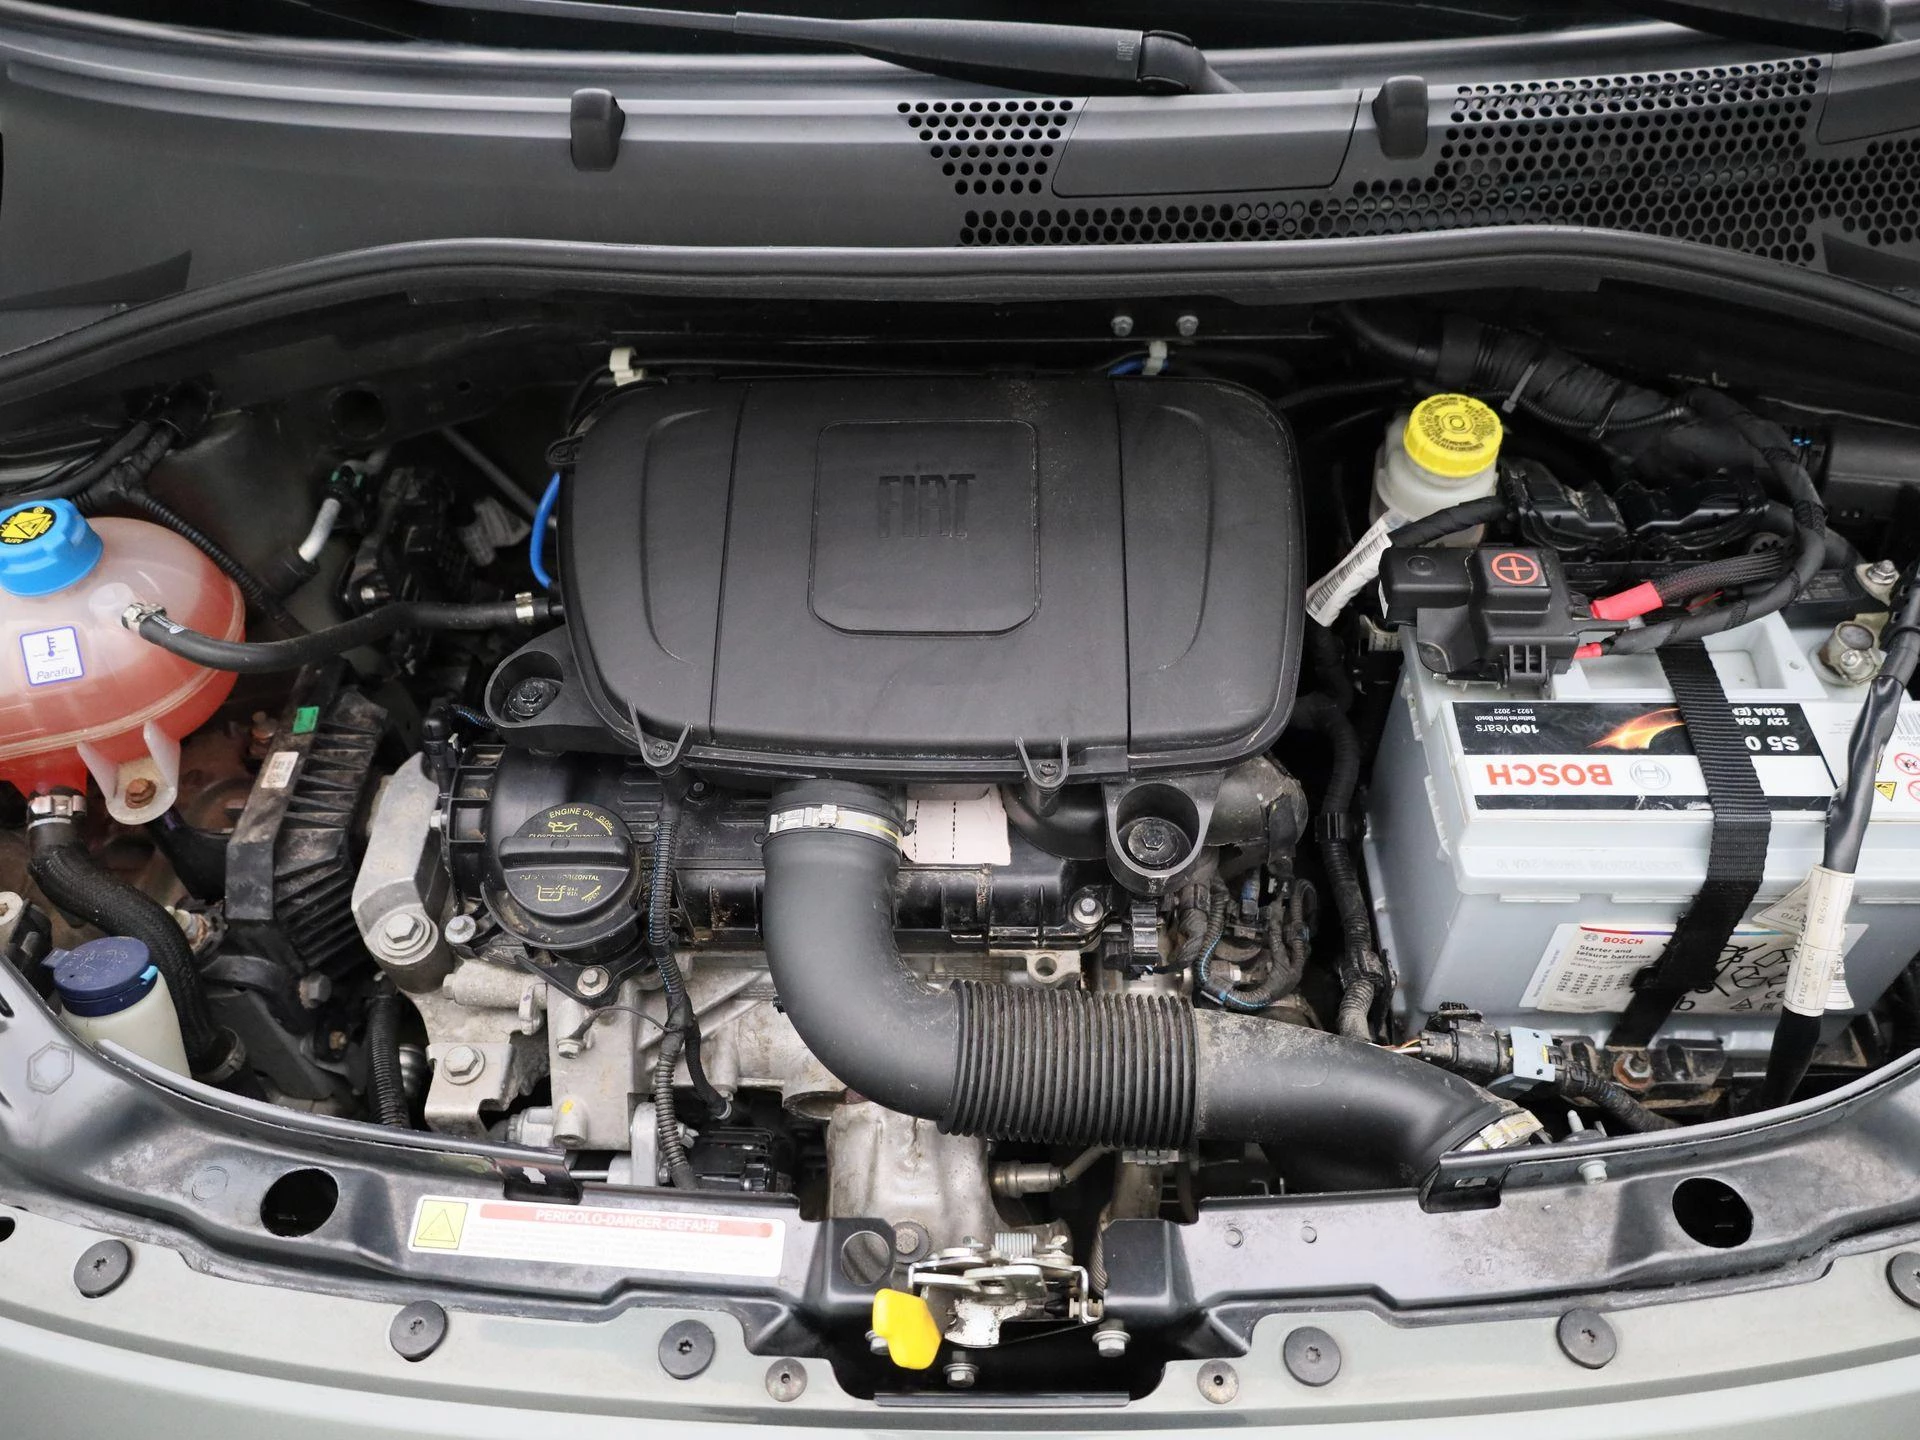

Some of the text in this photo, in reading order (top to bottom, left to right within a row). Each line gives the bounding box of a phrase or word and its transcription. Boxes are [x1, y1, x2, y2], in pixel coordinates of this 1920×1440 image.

[879, 473, 976, 538] FIAT
[36, 666, 76, 681] Paraflu
[1753, 707, 1786, 716] 610A
[1767, 717, 1790, 726] 12V
[1767, 735, 1800, 751] S5
[1485, 763, 1613, 786] BOSCH
[549, 808, 594, 819] ENGINE OIL
[598, 815, 615, 830] CLOSE
[1602, 936, 1644, 945] BOSCH
[1579, 945, 1612, 953] Starter
[1674, 995, 1696, 1011] b
